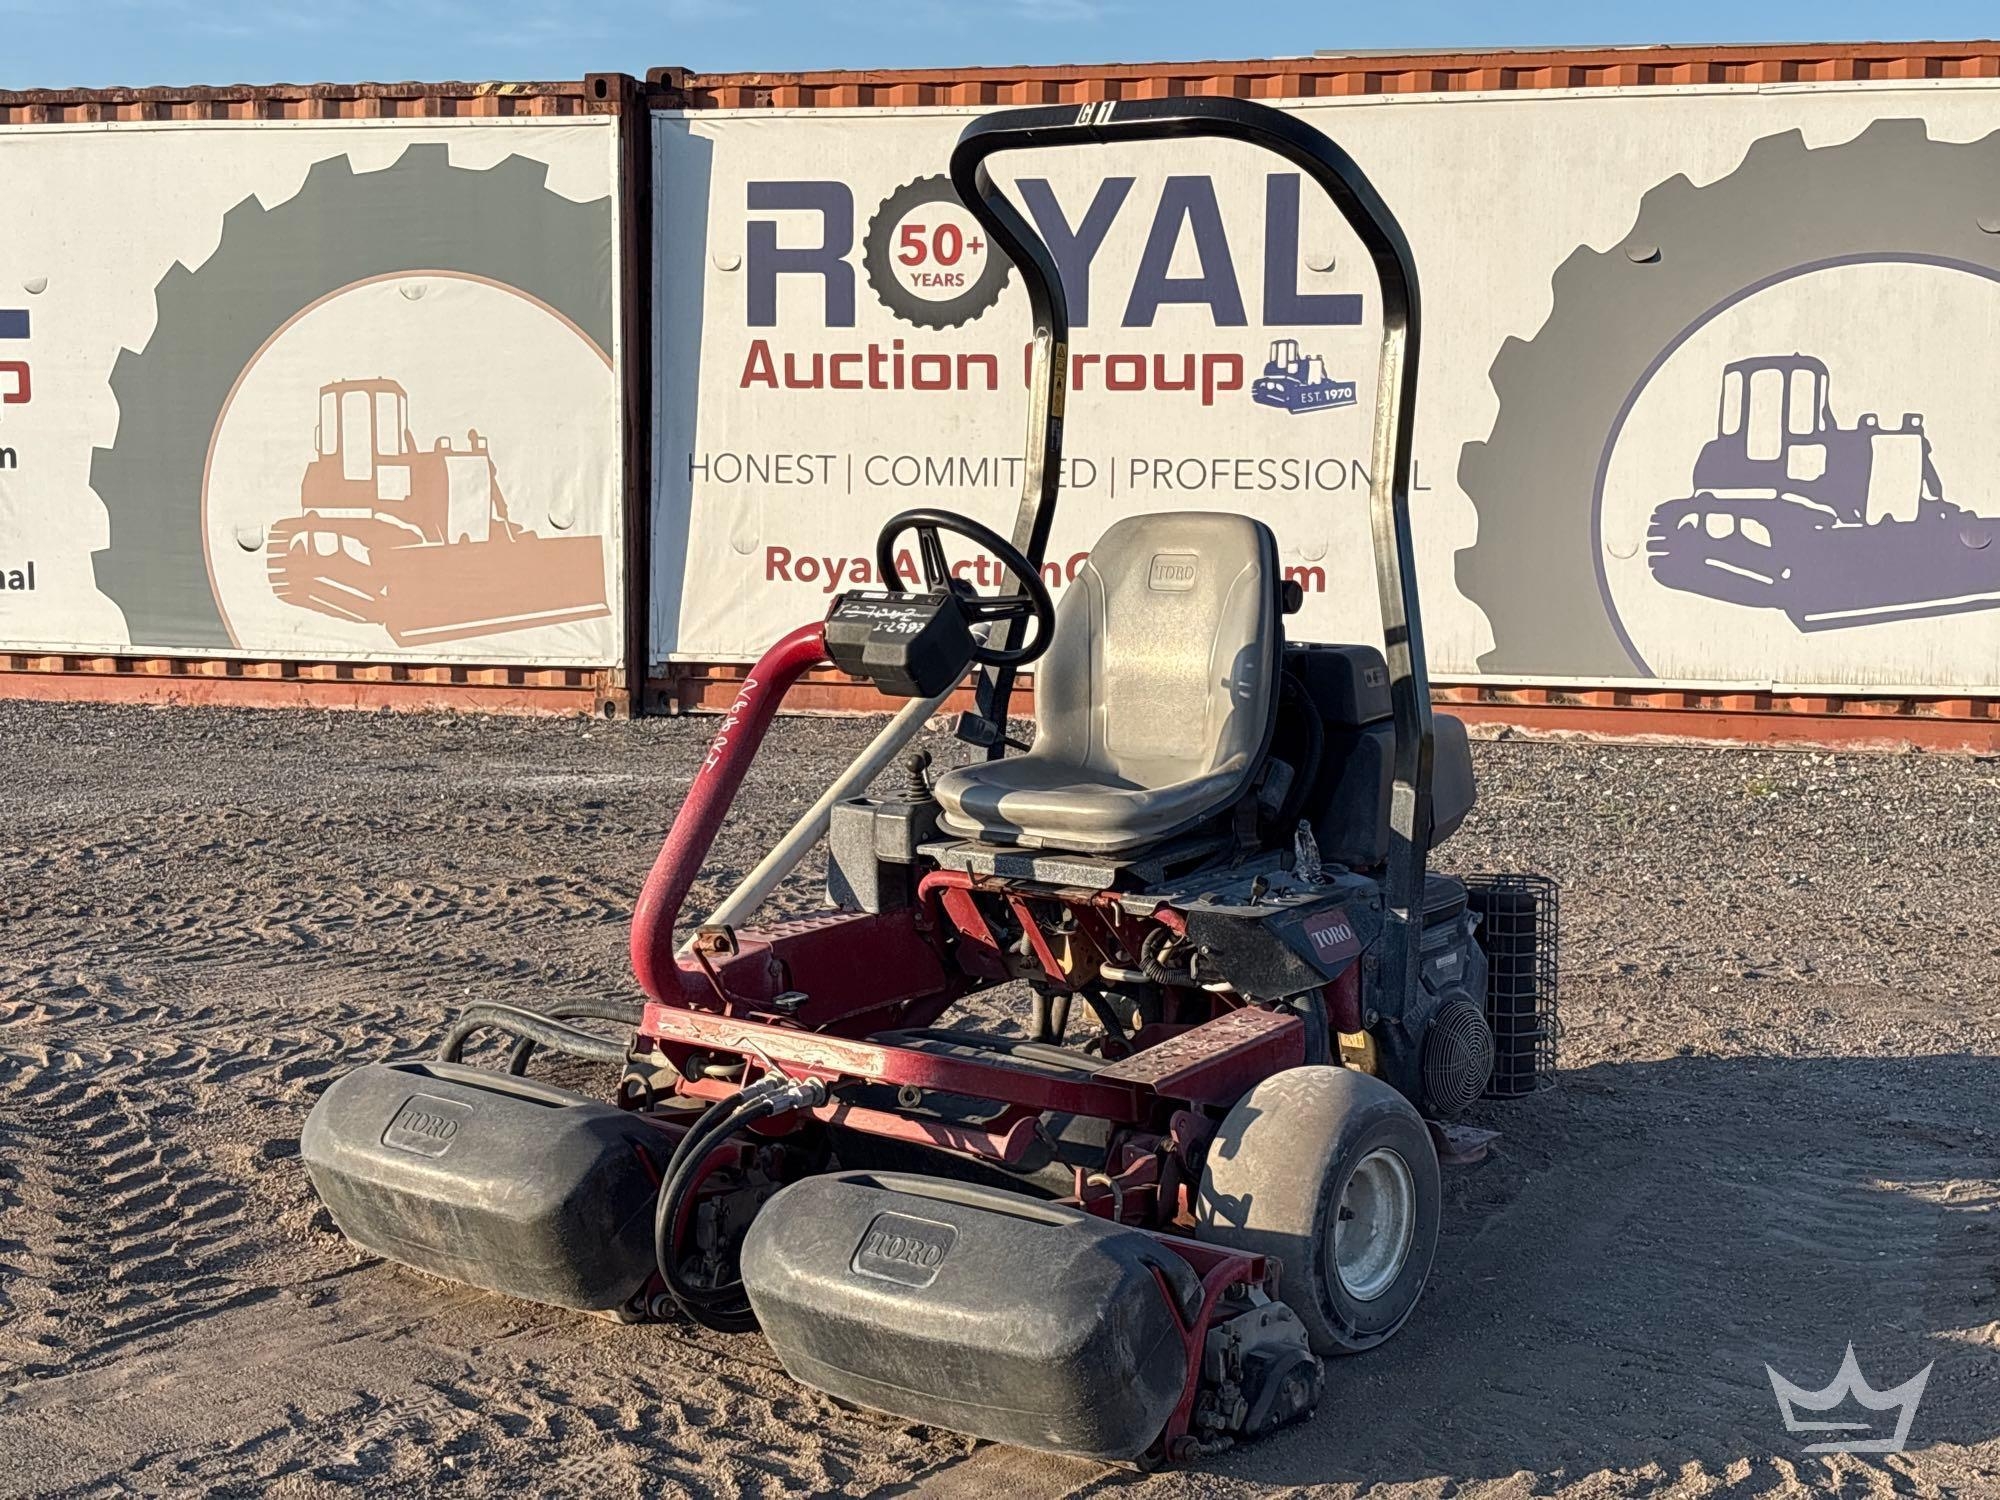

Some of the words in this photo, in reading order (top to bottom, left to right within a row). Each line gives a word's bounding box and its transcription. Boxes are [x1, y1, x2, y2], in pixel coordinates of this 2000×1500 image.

[898, 223, 984, 267] 50+
[911, 273, 965, 287] YEARS
[739, 338, 998, 391] Auction
[1025, 341, 1244, 406] roup
[1324, 387, 1352, 400] 1970
[689, 452, 837, 485] HONEST
[864, 455, 1096, 488] COMMITD
[1130, 458, 1432, 491] PROFESSIONL
[1311, 923, 1352, 949] TORO
[401, 1110, 458, 1140] TORO
[864, 1231, 944, 1267] TORO
